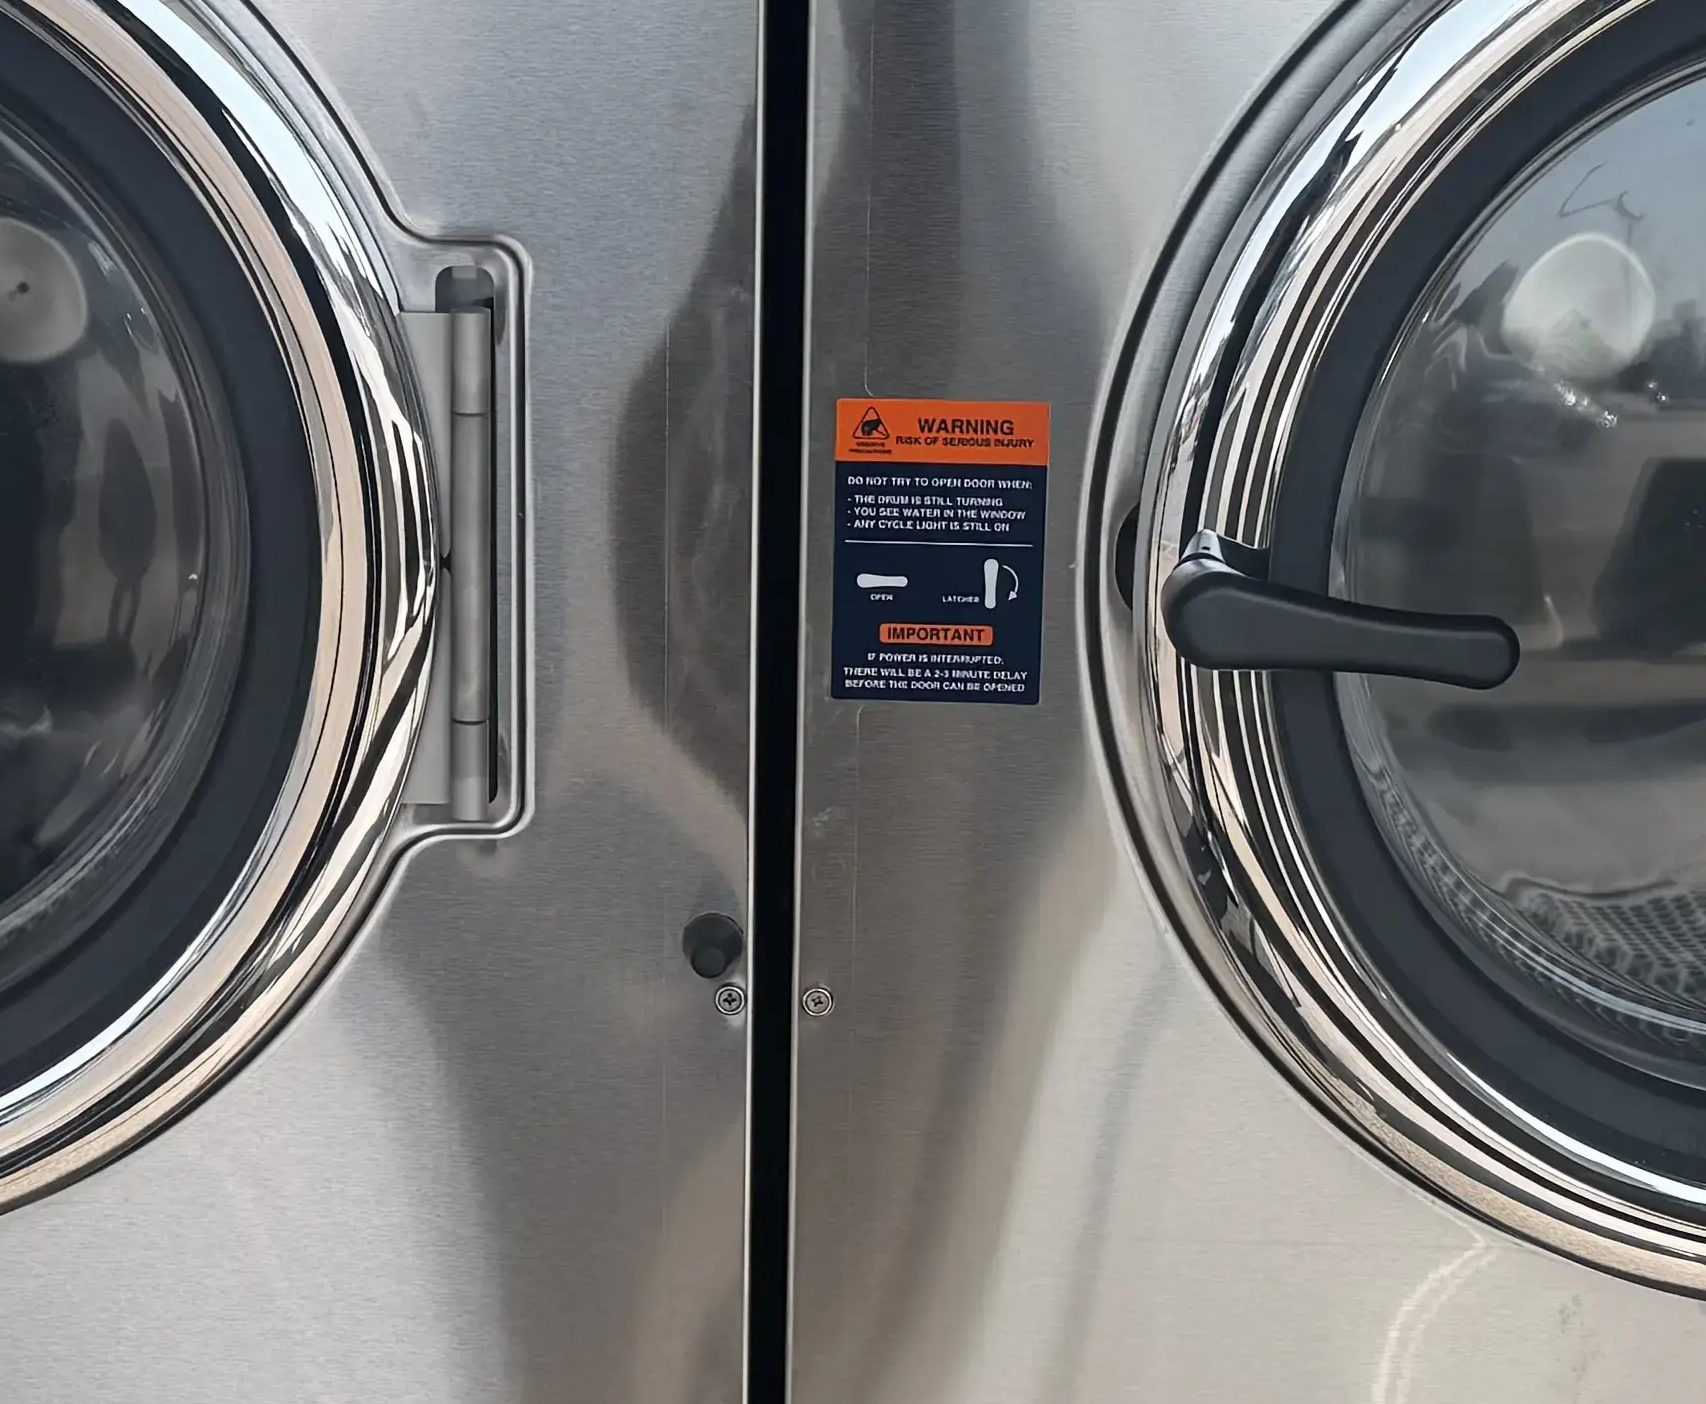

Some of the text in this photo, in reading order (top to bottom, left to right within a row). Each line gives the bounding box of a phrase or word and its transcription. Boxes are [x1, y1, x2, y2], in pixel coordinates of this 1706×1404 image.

[918, 418, 1014, 436] WARNING
[896, 436, 1034, 449] RISK OF SERIOUS INJURY
[887, 627, 985, 642] IMPORTANT
